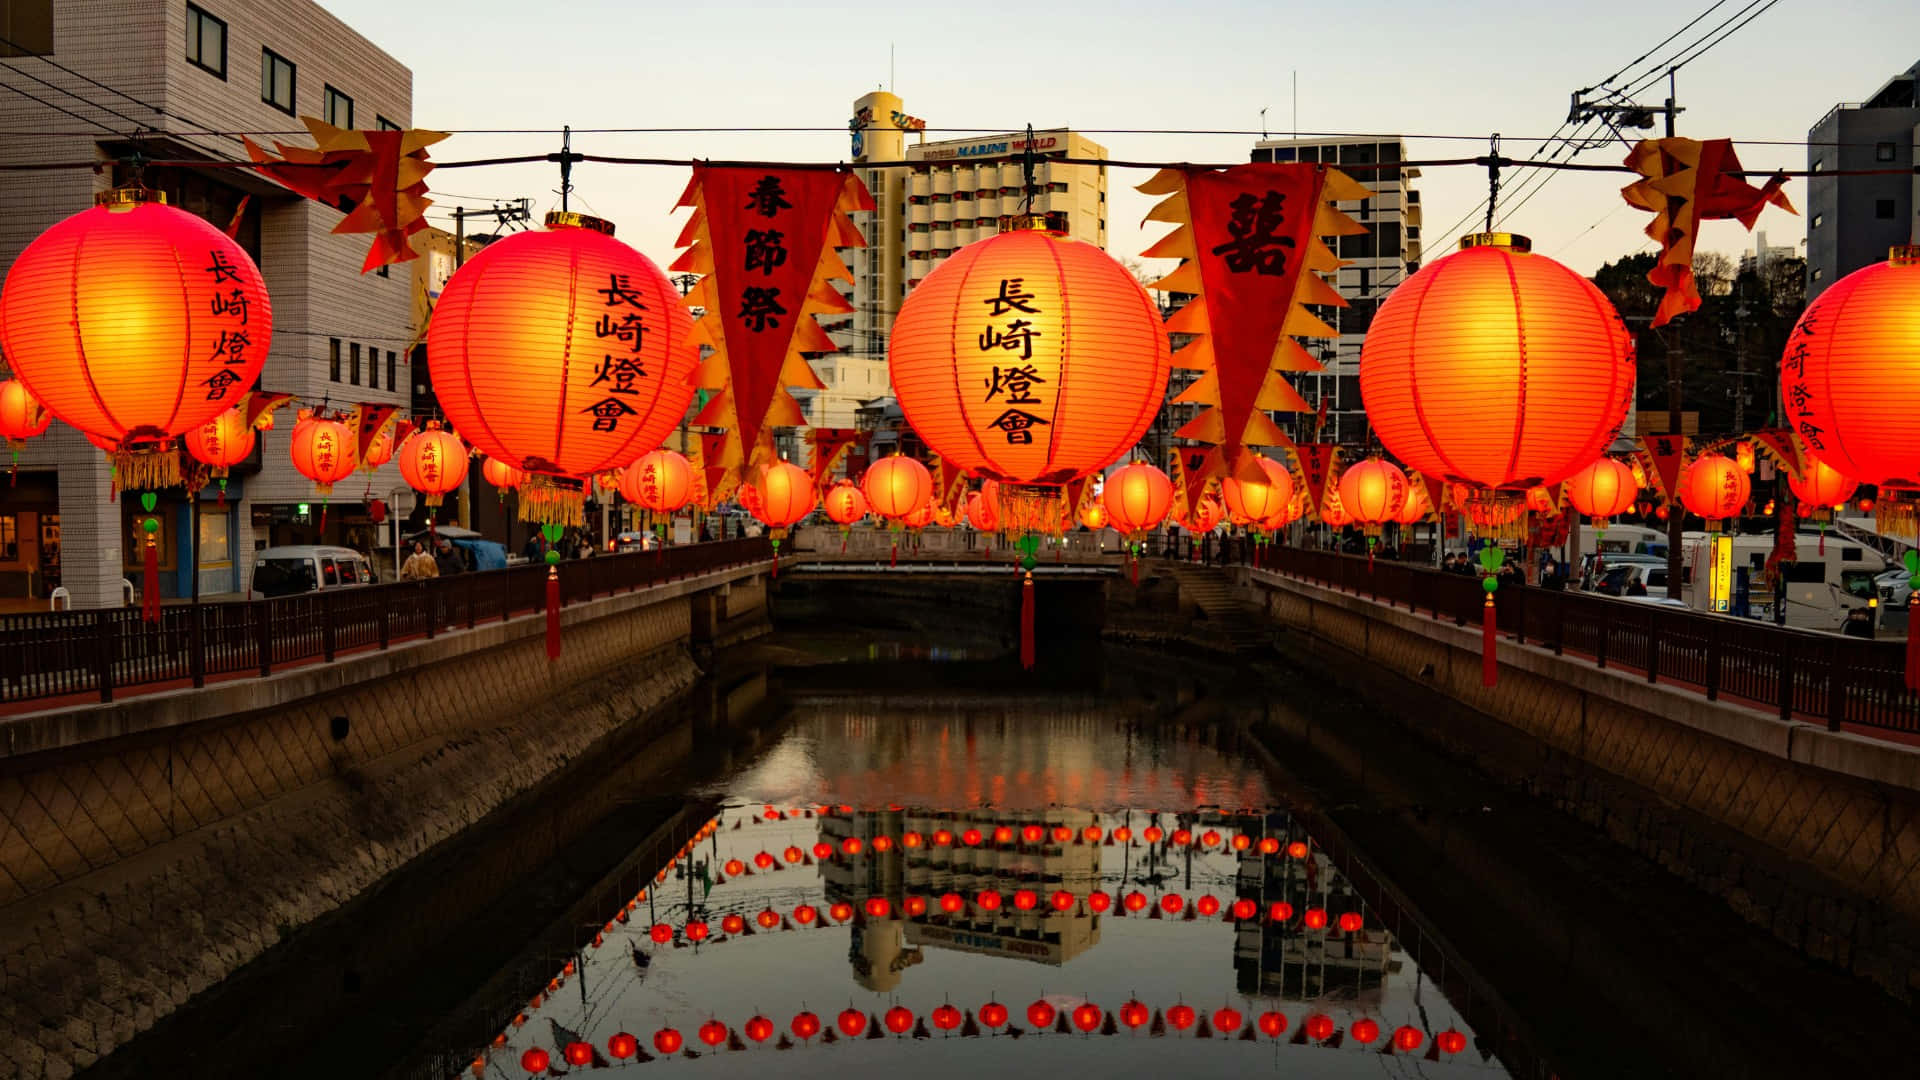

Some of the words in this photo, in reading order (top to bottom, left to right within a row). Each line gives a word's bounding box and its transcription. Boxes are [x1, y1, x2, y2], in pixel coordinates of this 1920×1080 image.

[923, 149, 956, 161] HOTEL
[957, 142, 1009, 157] MARINE
[1012, 137, 1057, 151] WRLD
[200, 250, 252, 400] 長崎燈會
[737, 175, 793, 333] 春節祭
[578, 273, 650, 432] 長崎燈會
[978, 278, 1051, 444] 長崎燈會
